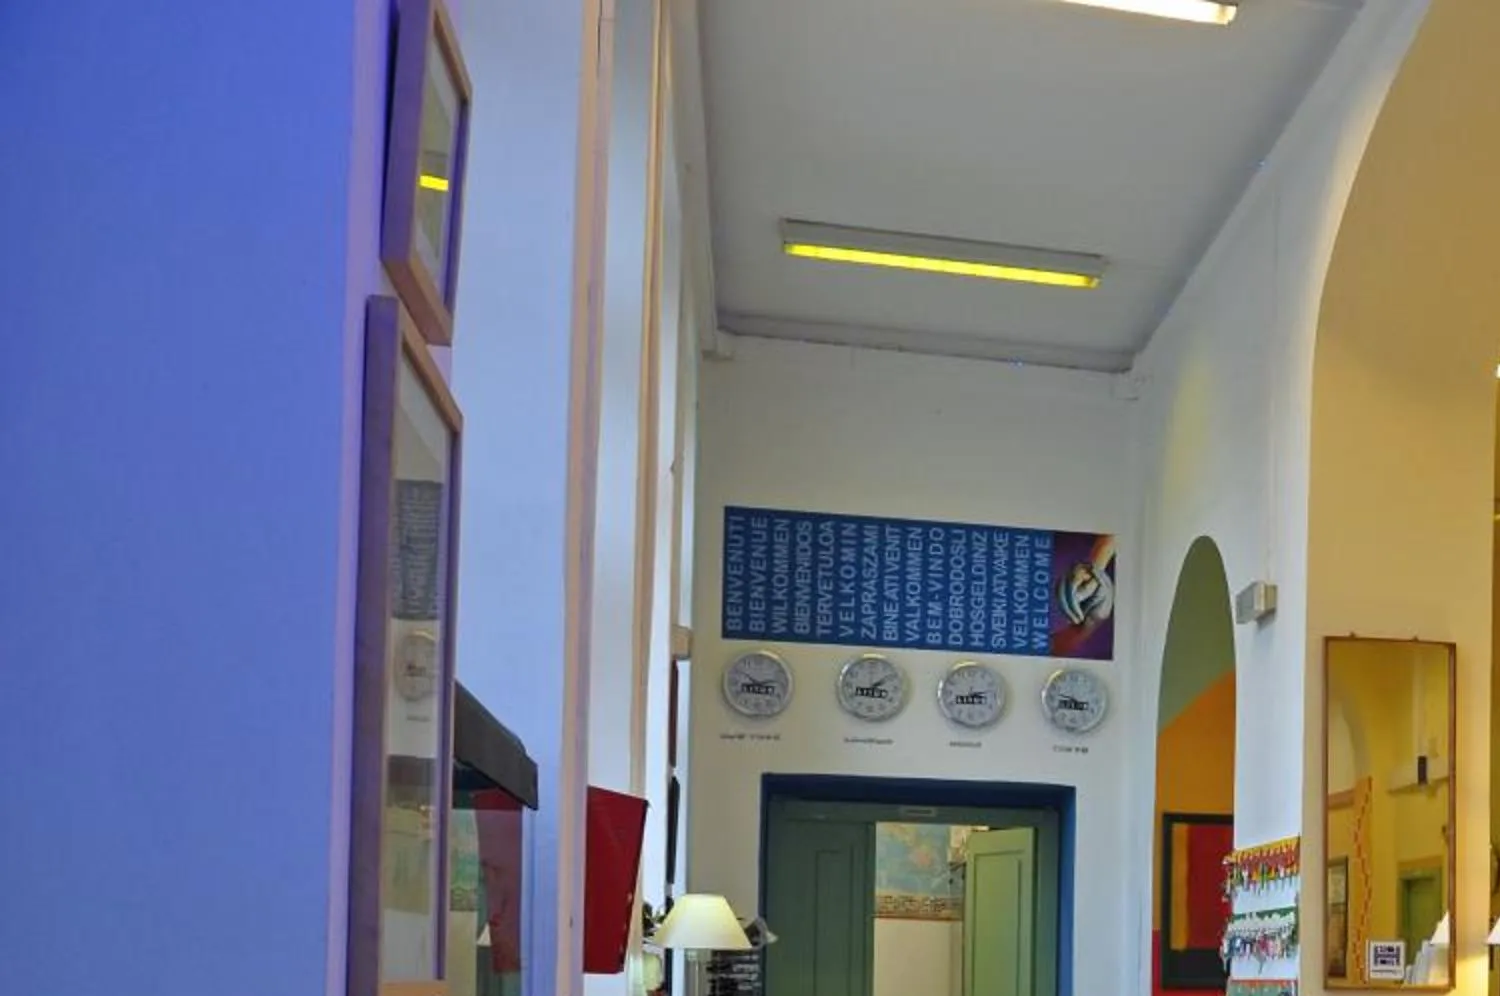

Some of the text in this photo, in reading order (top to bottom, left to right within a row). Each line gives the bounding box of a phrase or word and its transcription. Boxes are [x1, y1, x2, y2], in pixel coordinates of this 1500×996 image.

[726, 515, 745, 631] BENVENUTI
[749, 516, 768, 633] BIENVENUE
[771, 518, 790, 634] WILKOMMEN
[793, 520, 812, 635] BIENVENIDOS
[816, 521, 835, 637] TERVETULOA
[839, 523, 858, 637] VELKOMIN
[861, 524, 880, 640] ZAPRASZAMI
[885, 524, 900, 574] VENIT
[905, 526, 923, 642] VALKOMMEN
[926, 527, 945, 644] BEM-VINDO
[948, 529, 967, 646] DOBRODOSLI
[1013, 534, 1030, 649] VELKOMMEN
[1032, 536, 1050, 650] WELCOME
[883, 602, 899, 641] BINE
